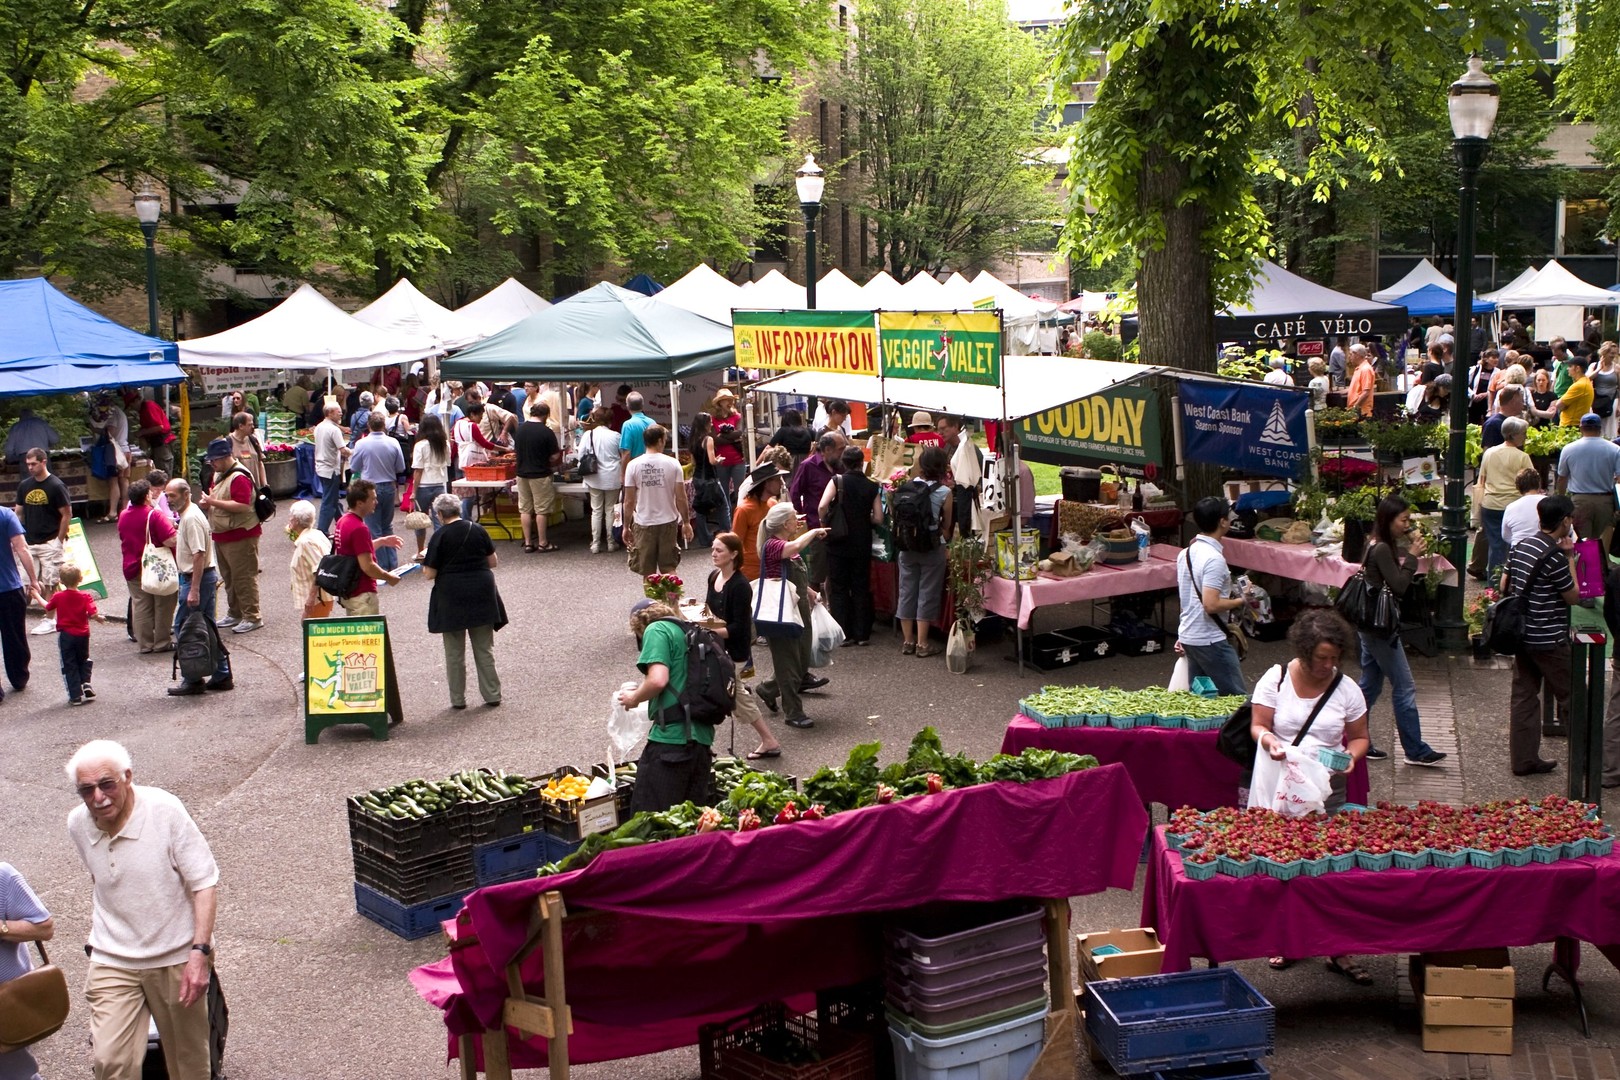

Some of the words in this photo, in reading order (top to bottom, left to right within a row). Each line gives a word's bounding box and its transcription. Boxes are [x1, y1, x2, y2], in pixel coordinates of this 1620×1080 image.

[1254, 315, 1306, 339] CAFÉ
[1320, 313, 1372, 335] VÉLO
[755, 330, 874, 371] INFORMATION
[883, 339, 936, 370] VEGGIE
[949, 340, 994, 375] VALET
[1184, 403, 1207, 418] West
[1207, 406, 1230, 421] Coast
[1231, 408, 1252, 424] Bank
[1195, 420, 1218, 431] Season
[1218, 422, 1243, 436] Sponsor
[918, 439, 939, 448] CREW
[1025, 433, 1037, 442] PROUD
[1038, 435, 1054, 444] SPONSOR
[1060, 438, 1068, 446] THE
[1068, 439, 1088, 449] PORTLAND
[1088, 442, 1106, 452] FARMERS
[1106, 445, 1122, 454] MARKET
[1122, 447, 1135, 456] SINCE
[1249, 445, 1272, 457] WEST
[1264, 457, 1291, 469] BANK
[313, 626, 326, 634] TOO
[326, 625, 345, 634] MUCH
[347, 625, 355, 633] TO
[356, 624, 380, 633] CARRY?
[312, 640, 327, 648] Leave
[328, 640, 341, 648] Your
[362, 638, 381, 646] HERE!
[346, 670, 375, 681] VEGGIE
[348, 680, 373, 691] VALET
